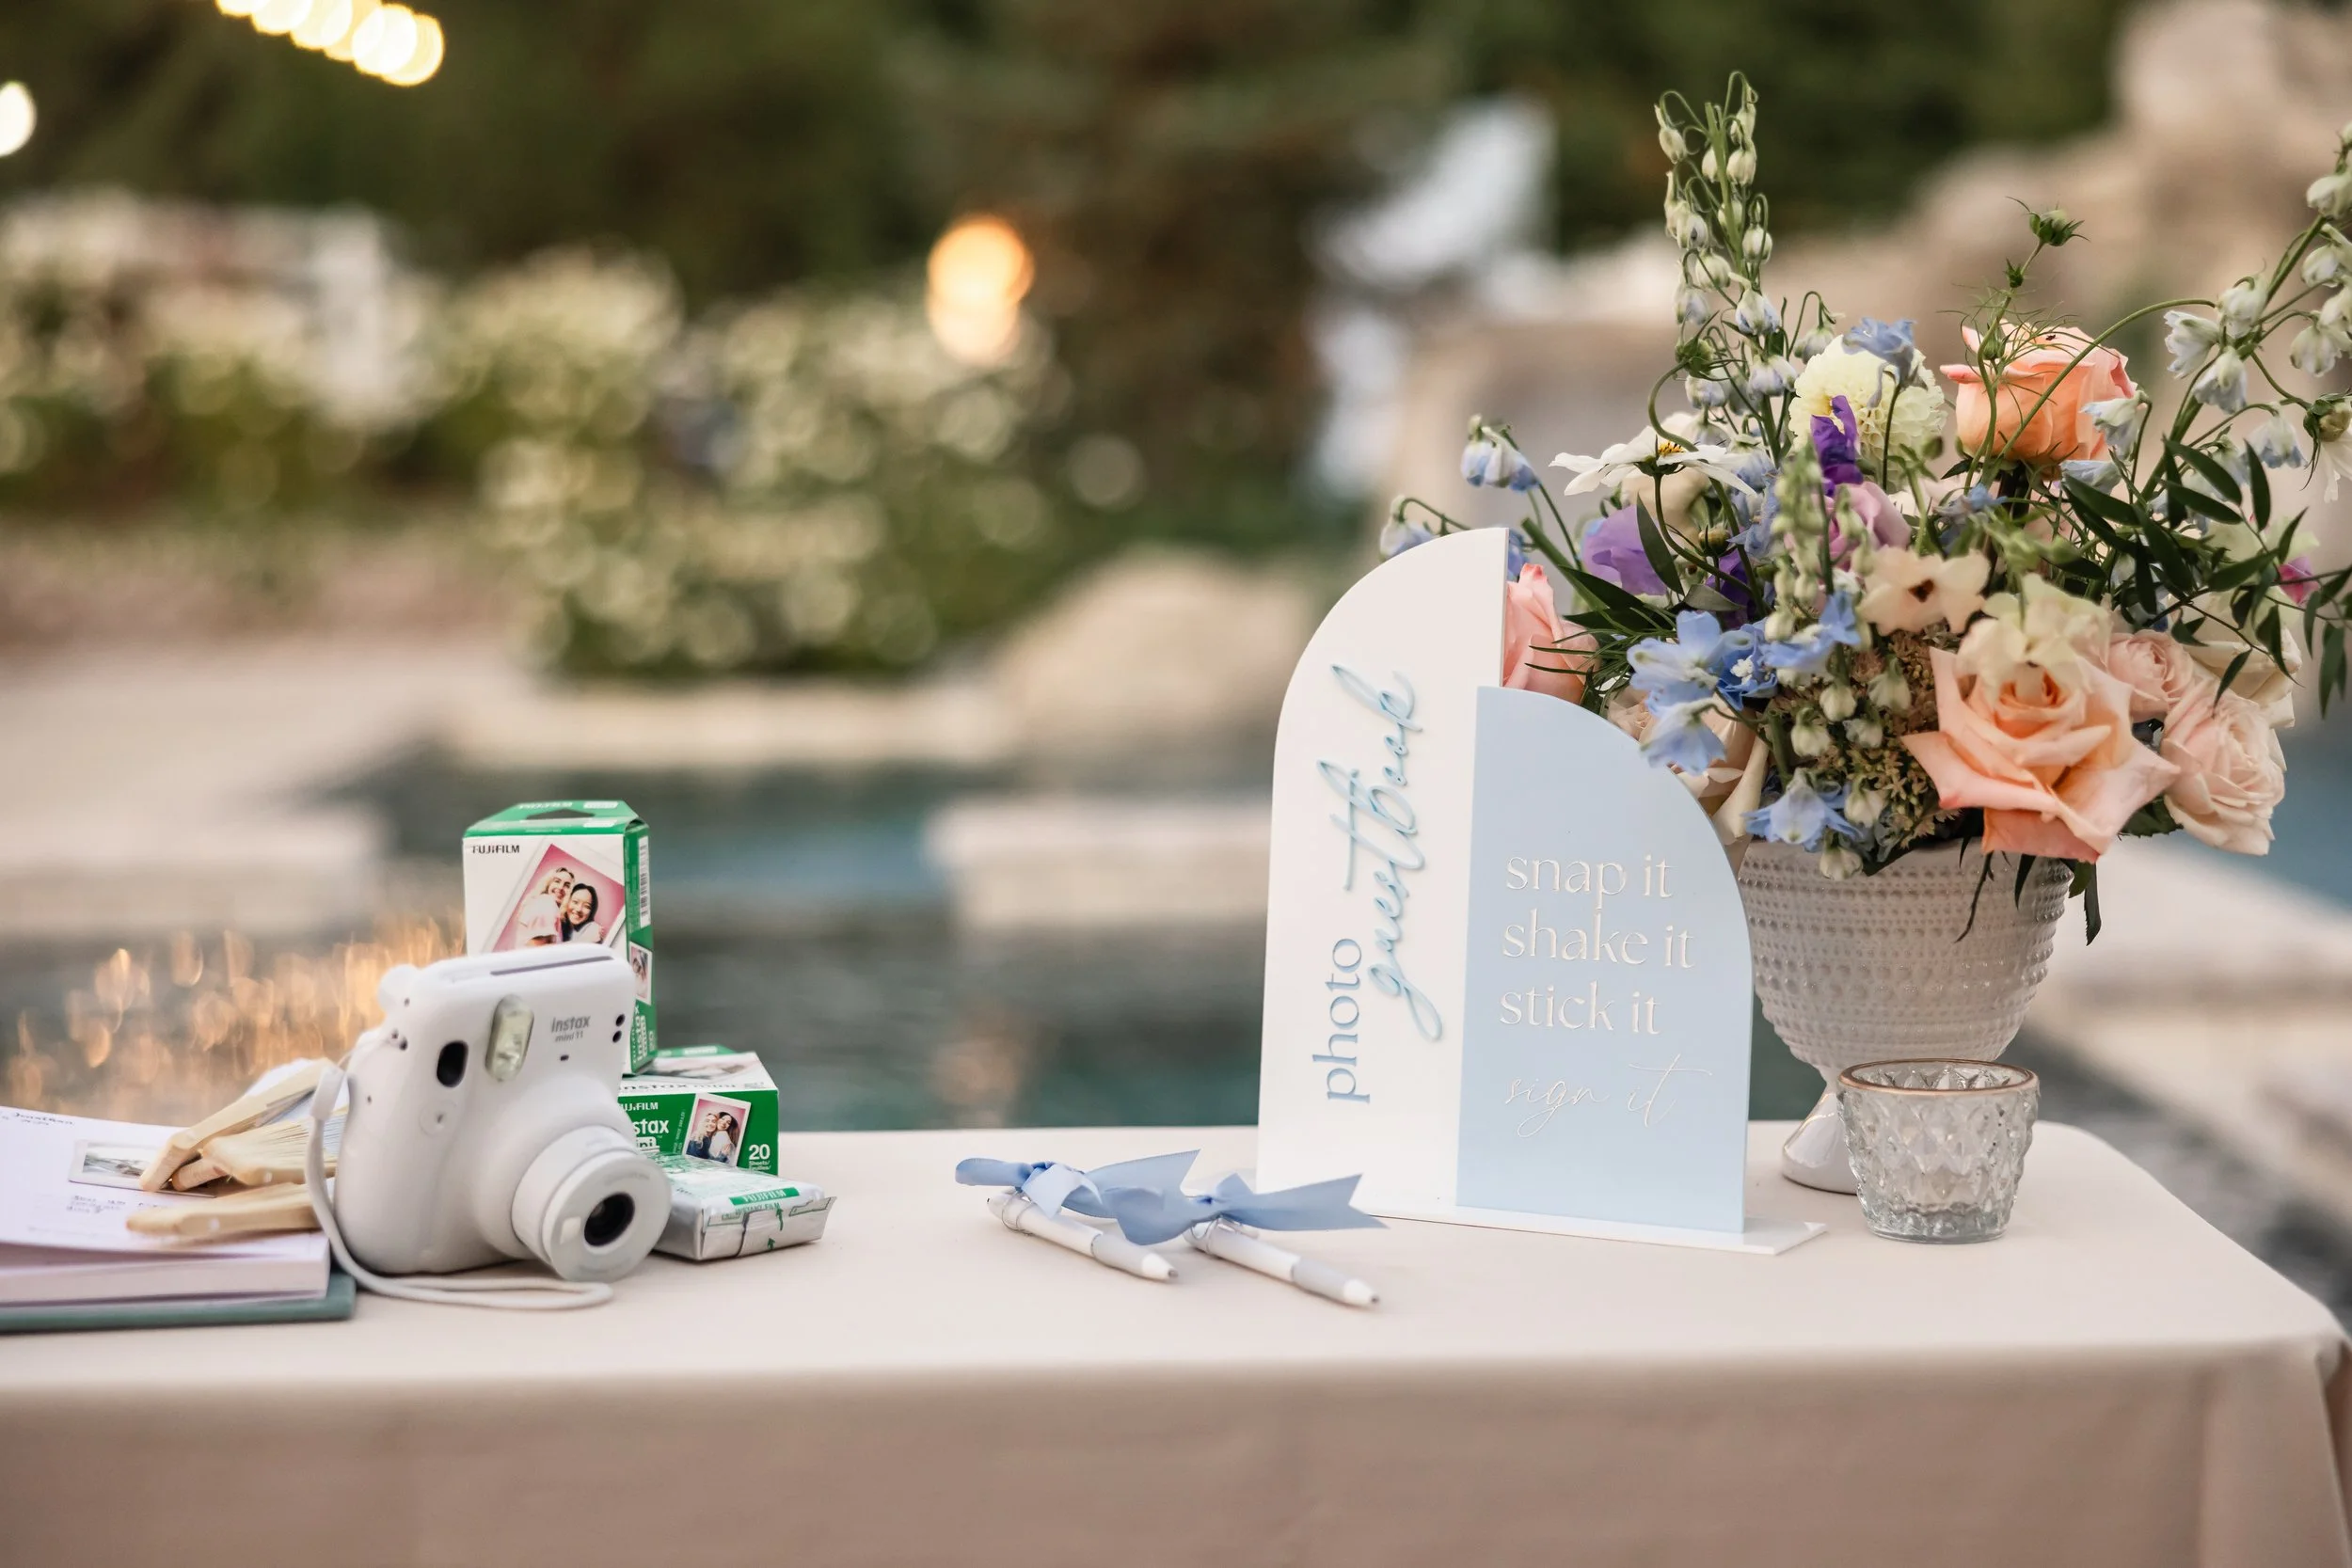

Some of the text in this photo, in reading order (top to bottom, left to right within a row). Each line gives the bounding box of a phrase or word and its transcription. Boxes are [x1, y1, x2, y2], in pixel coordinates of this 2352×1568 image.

[472, 845, 520, 854] FUJIFILM
[1505, 854, 1676, 910] snap it
[1502, 908, 1695, 969] shake it
[1499, 980, 1661, 1035] stick it
[550, 1015, 591, 1034] instax
[1311, 937, 1371, 1104] photo
[554, 1030, 584, 1043] mini 11
[1504, 1053, 1713, 1138] sign it
[621, 1101, 659, 1112] UJIFILM
[632, 1118, 670, 1135] stax
[748, 1143, 771, 1161] 20
[741, 1189, 787, 1203] FUJIFILM
